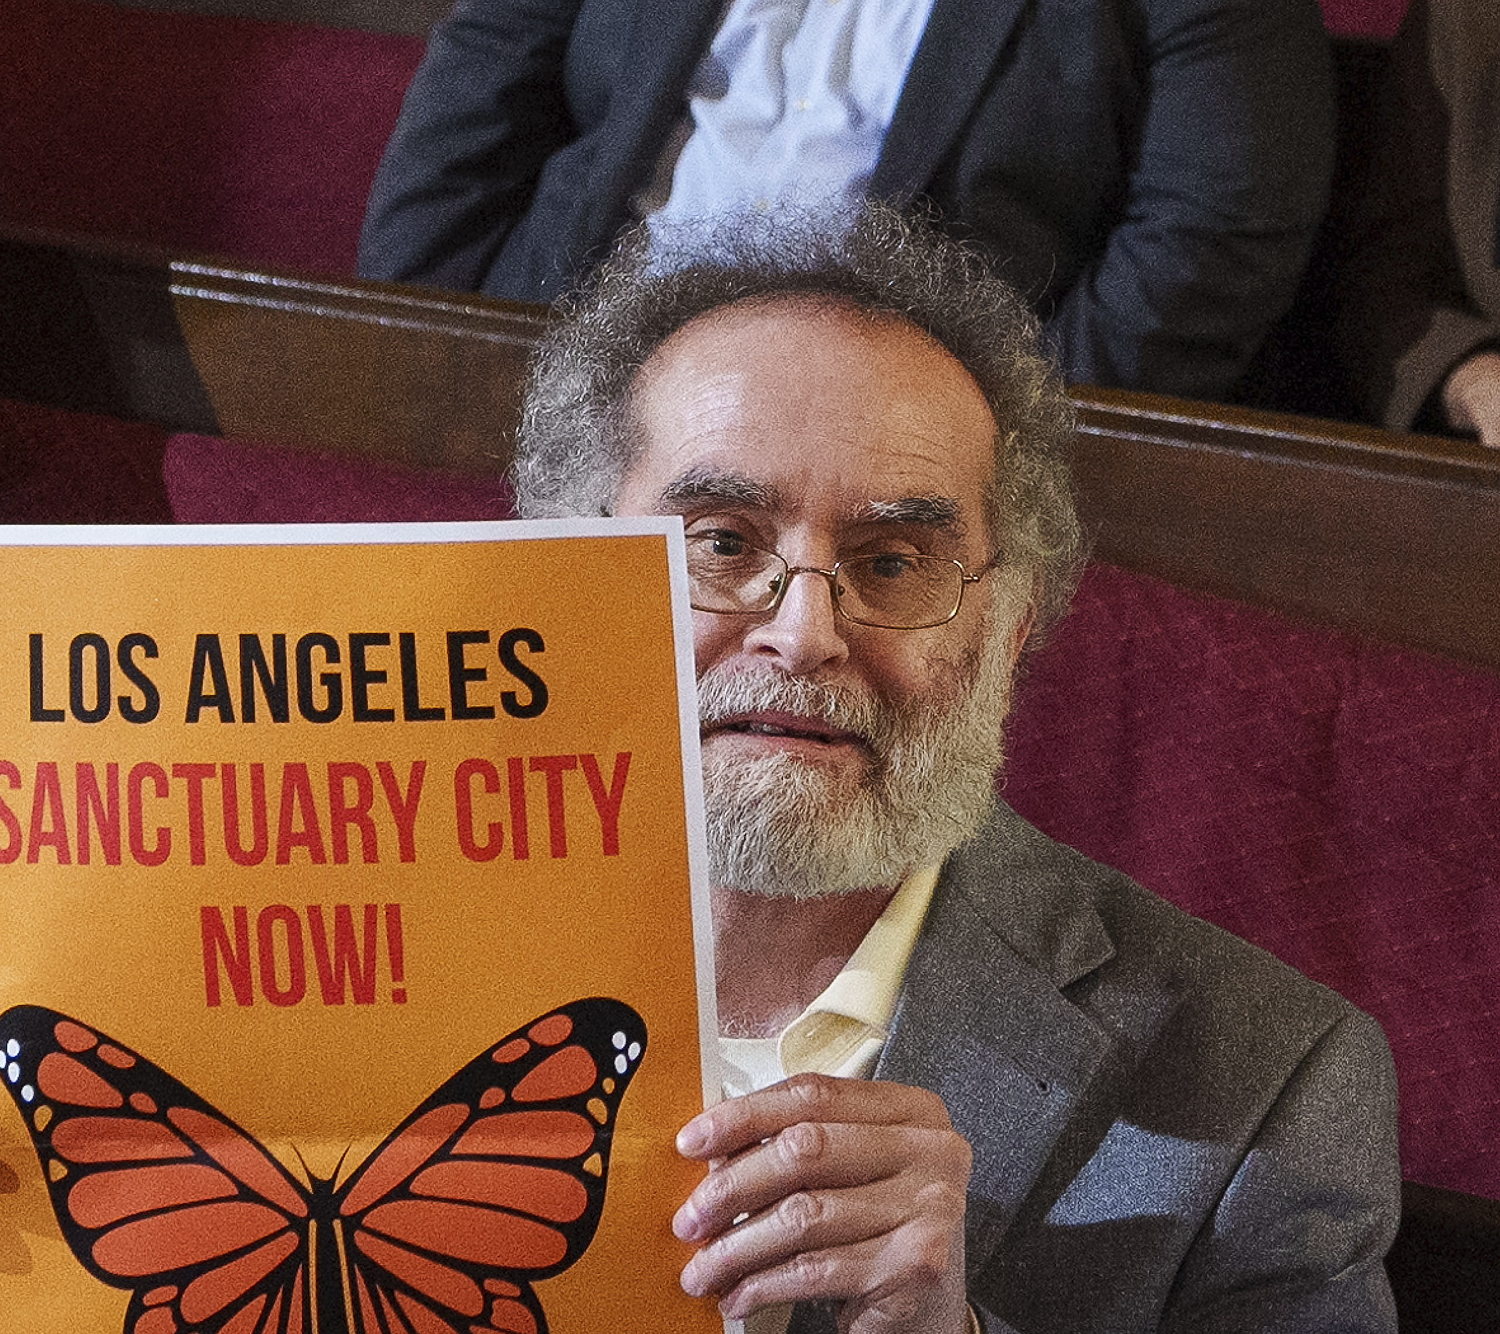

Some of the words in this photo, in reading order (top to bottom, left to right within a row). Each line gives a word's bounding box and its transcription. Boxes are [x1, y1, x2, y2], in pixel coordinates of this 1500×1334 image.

[28, 631, 161, 724] LOS
[185, 627, 549, 724] ANGELES
[455, 751, 632, 863] CITY
[200, 903, 408, 1008] NOW!
